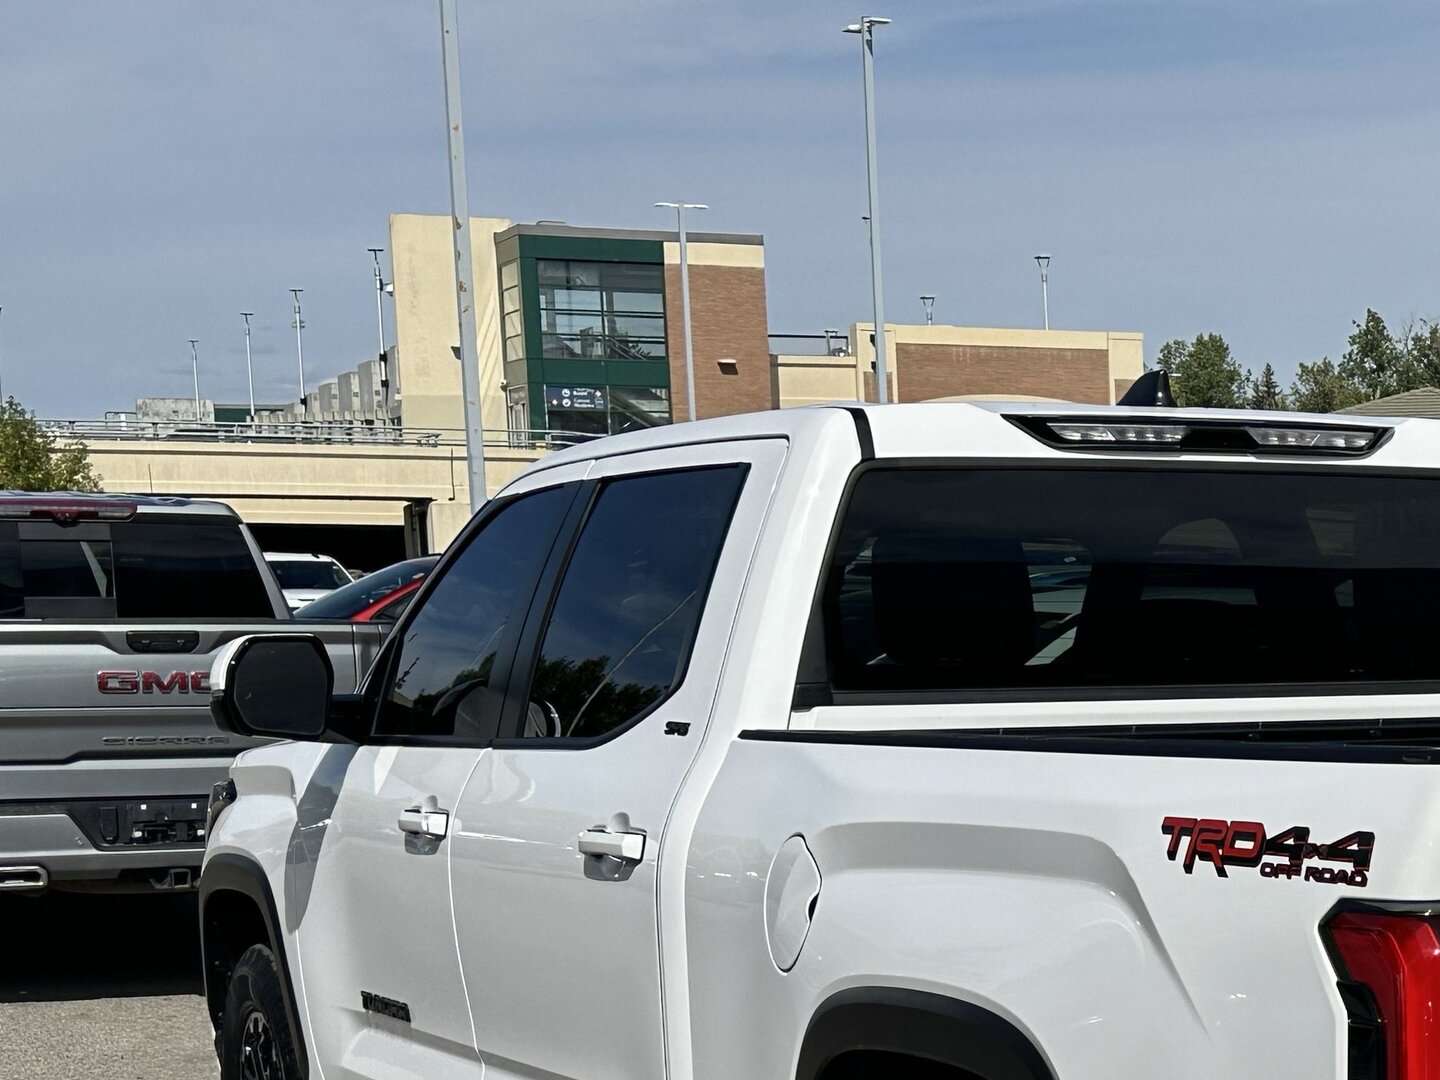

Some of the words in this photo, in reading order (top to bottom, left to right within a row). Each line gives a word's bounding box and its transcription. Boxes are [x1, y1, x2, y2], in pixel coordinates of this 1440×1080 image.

[101, 736, 230, 746] SIERRA
[1161, 816, 1267, 878] TRD
[1259, 862, 1301, 880] OFF
[1304, 866, 1368, 888] ROAD
